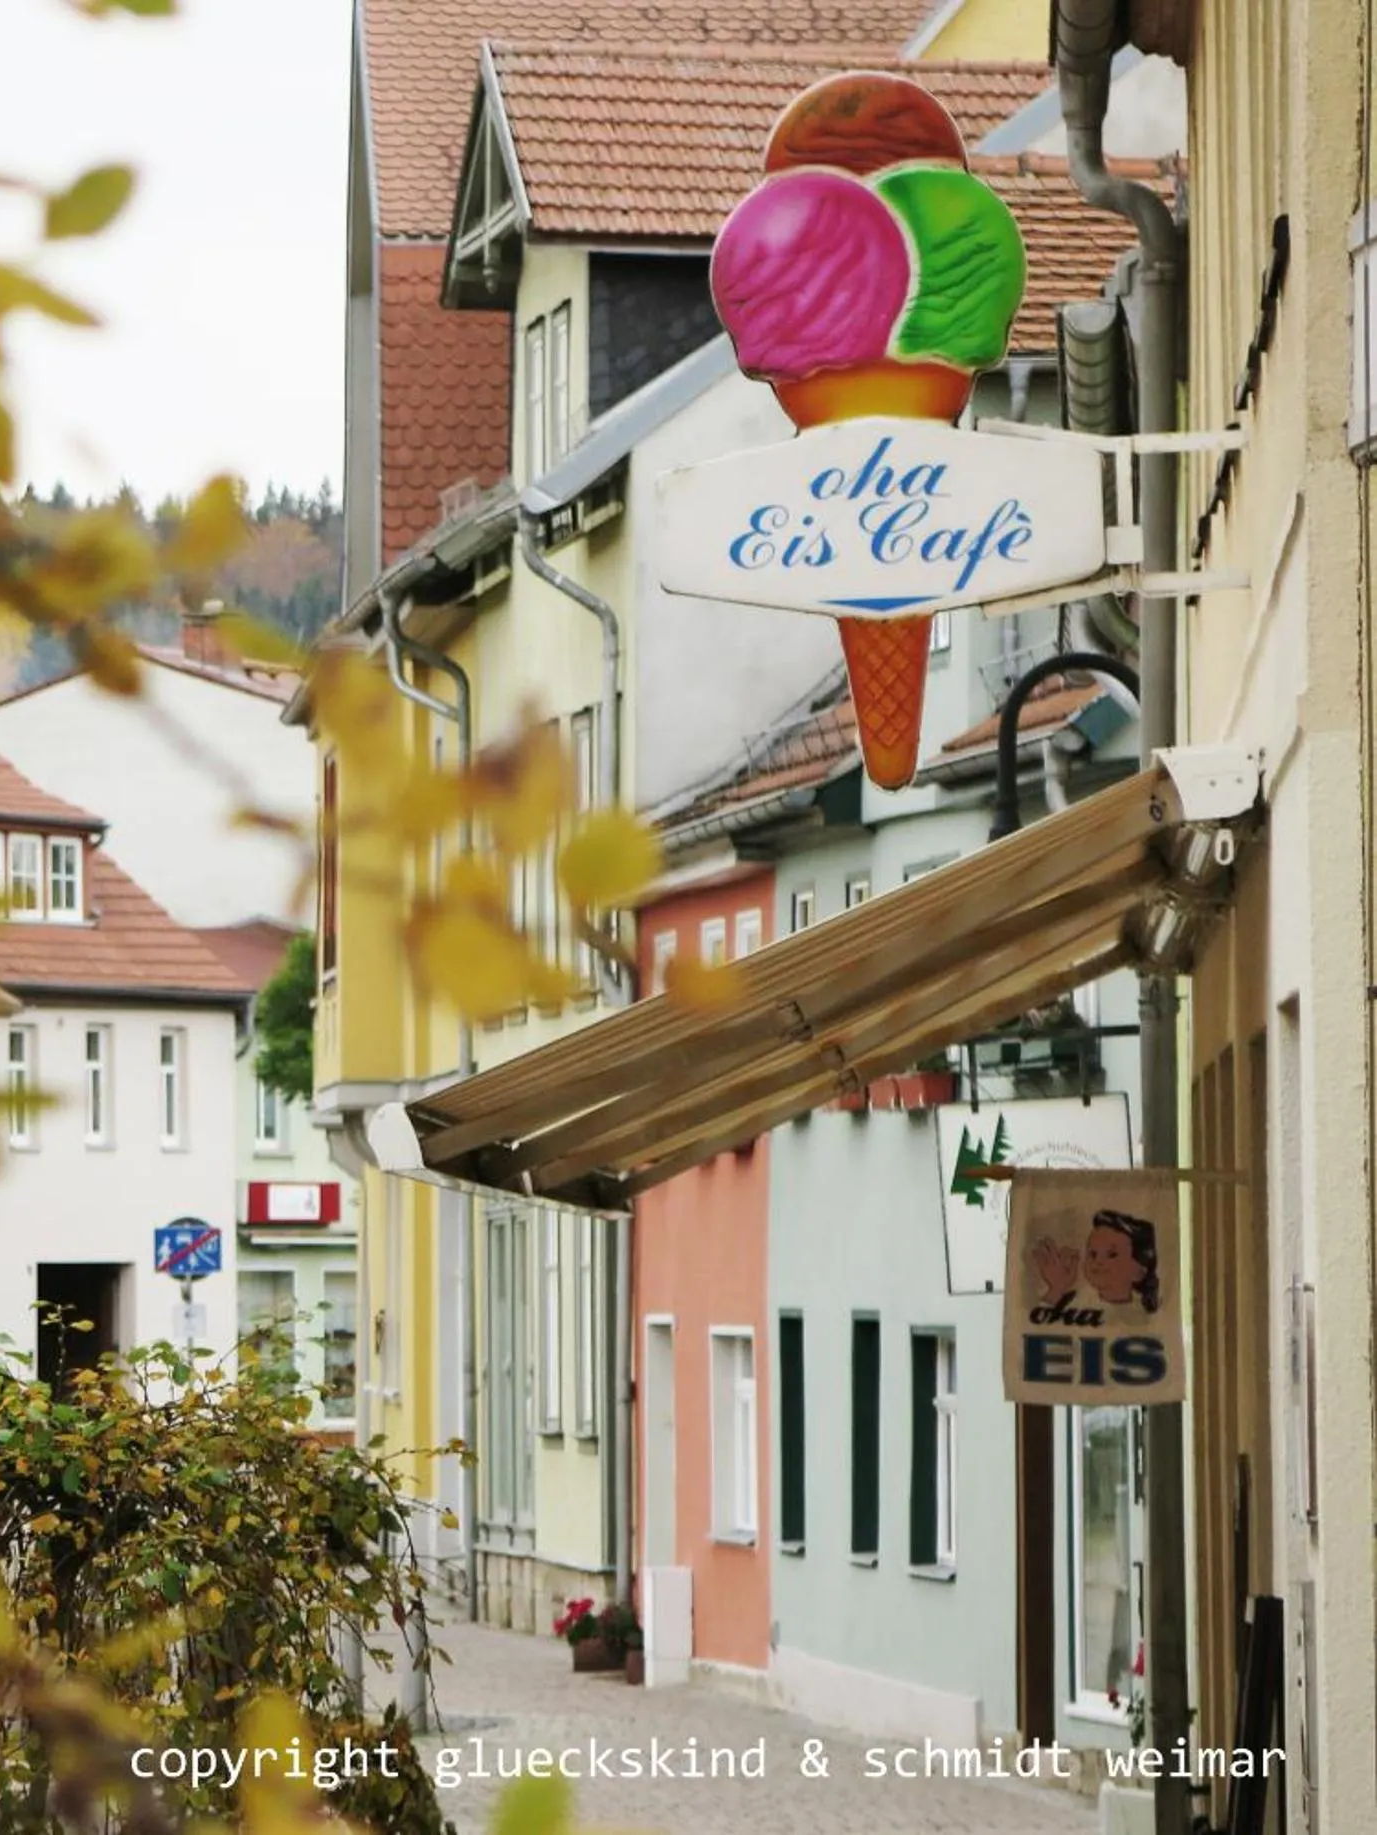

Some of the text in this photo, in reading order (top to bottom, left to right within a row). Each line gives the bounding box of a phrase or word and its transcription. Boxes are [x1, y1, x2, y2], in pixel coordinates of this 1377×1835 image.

[808, 436, 950, 500] oha
[727, 504, 839, 569] Eis
[1029, 1291, 1103, 1327] oha
[1023, 1333, 1167, 1387] EIS
